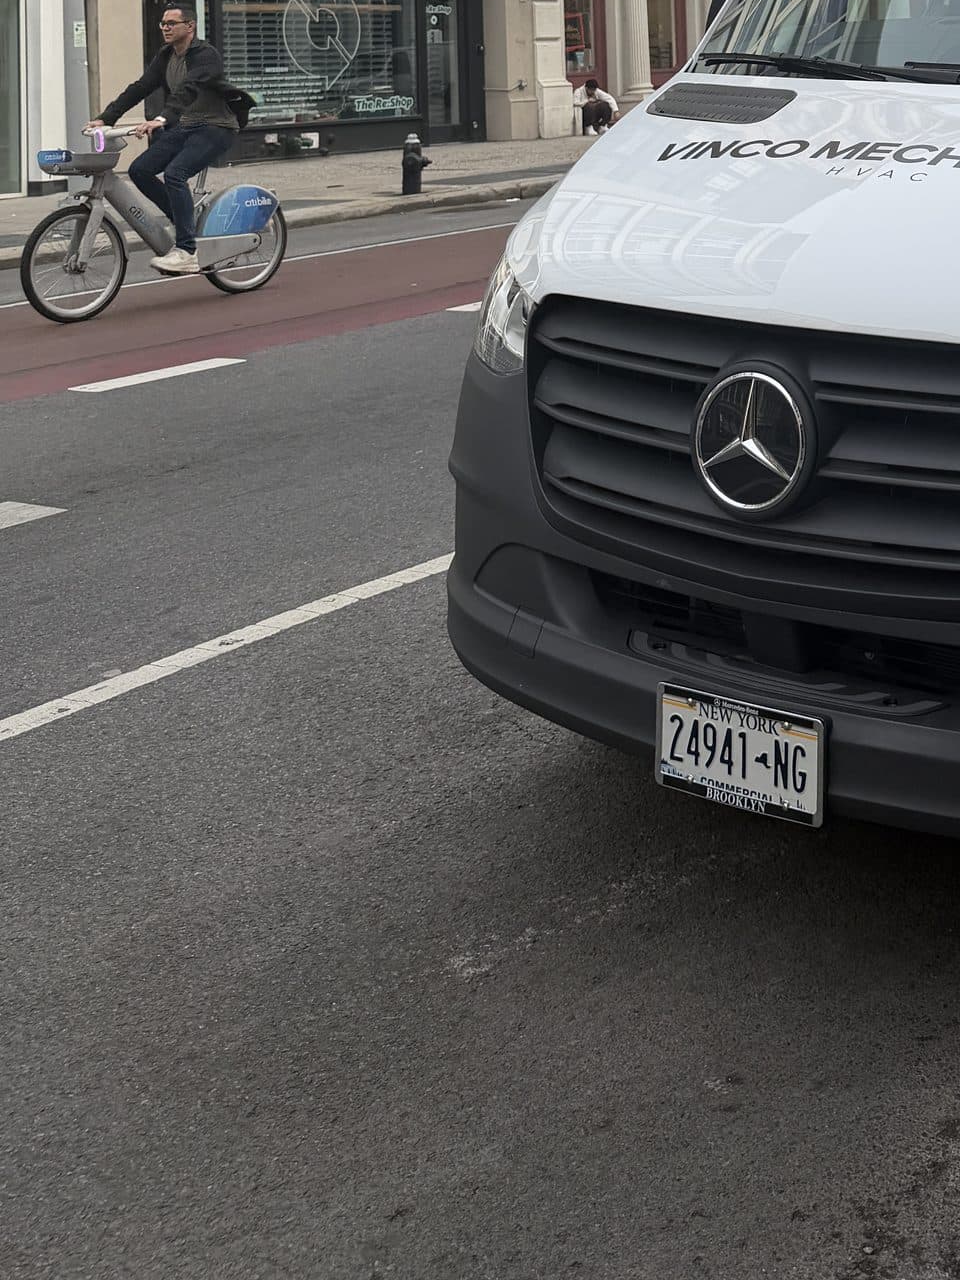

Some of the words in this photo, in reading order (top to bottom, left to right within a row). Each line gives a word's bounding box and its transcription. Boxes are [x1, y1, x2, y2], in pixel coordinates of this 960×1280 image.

[355, 99, 374, 112] The
[657, 140, 810, 161] VINCO
[699, 704, 733, 724] NEW
[737, 712, 780, 736] YORK
[669, 713, 747, 779] 24941
[774, 739, 807, 793] NG
[706, 787, 767, 813] BROOKLYN
